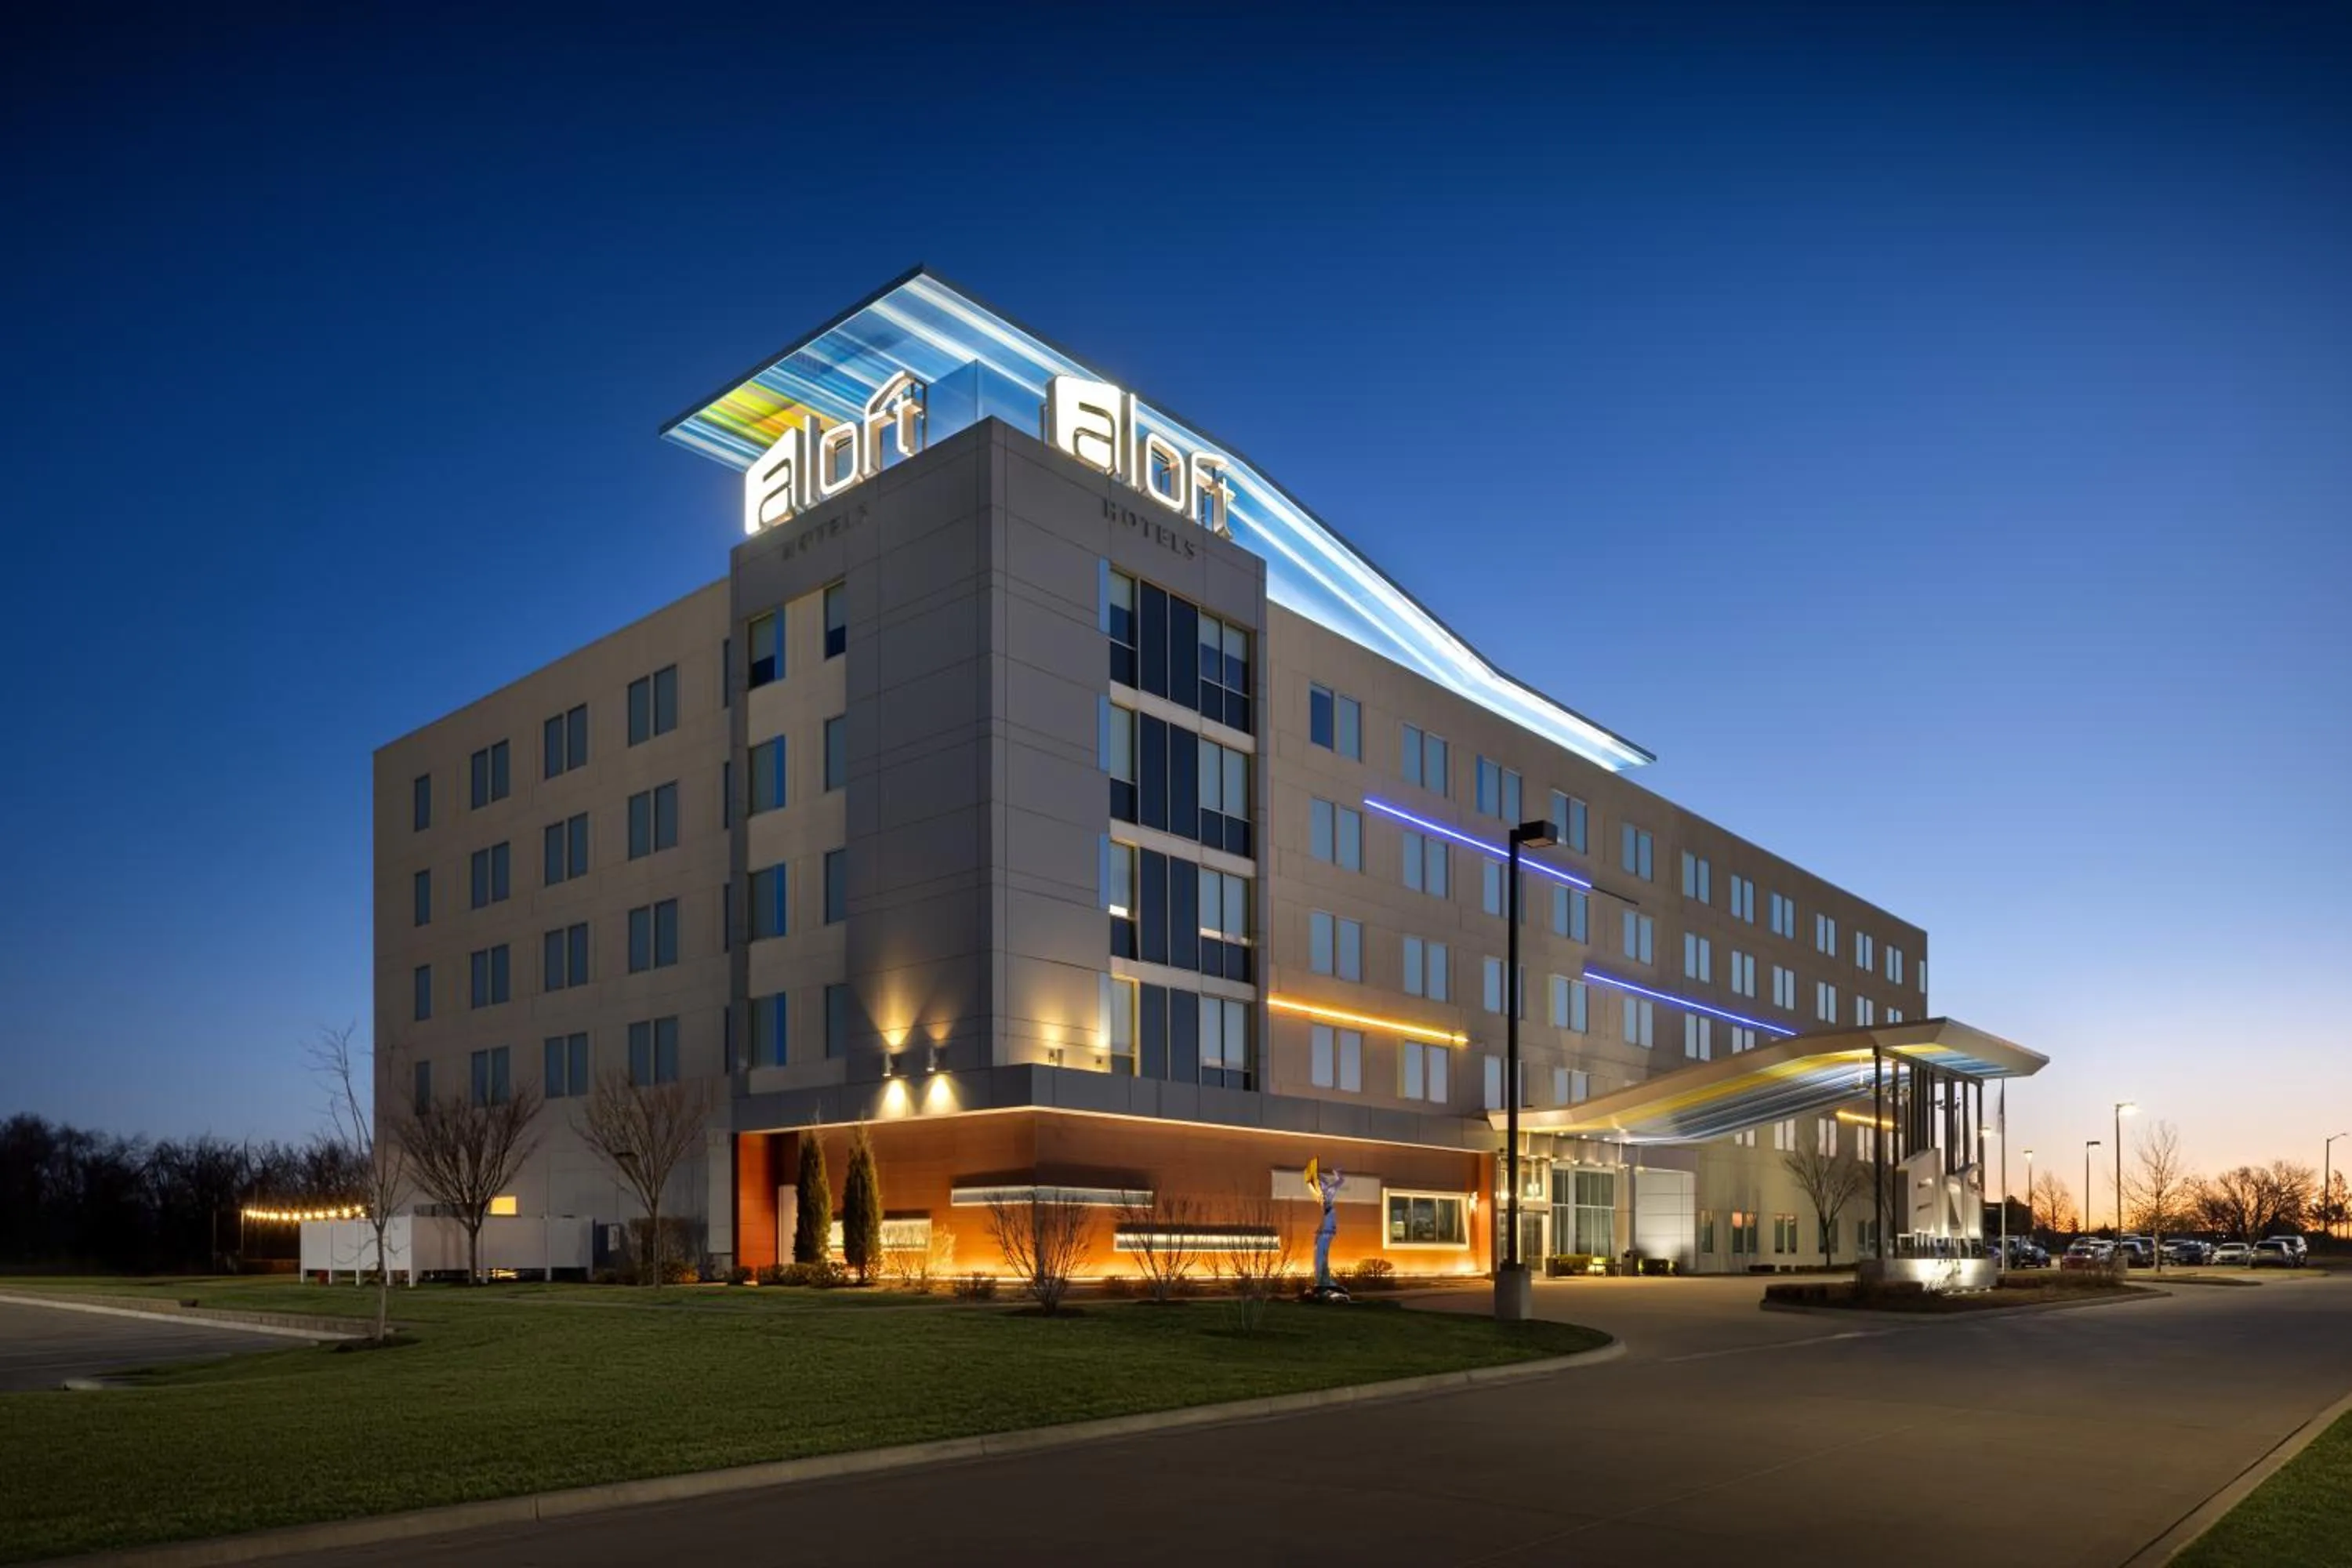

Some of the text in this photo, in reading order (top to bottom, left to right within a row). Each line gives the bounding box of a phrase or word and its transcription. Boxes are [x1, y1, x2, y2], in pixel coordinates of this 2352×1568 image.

[744, 370, 926, 535] aloft
[1045, 375, 1236, 539] aloft
[1103, 497, 1196, 559] HOTELS
